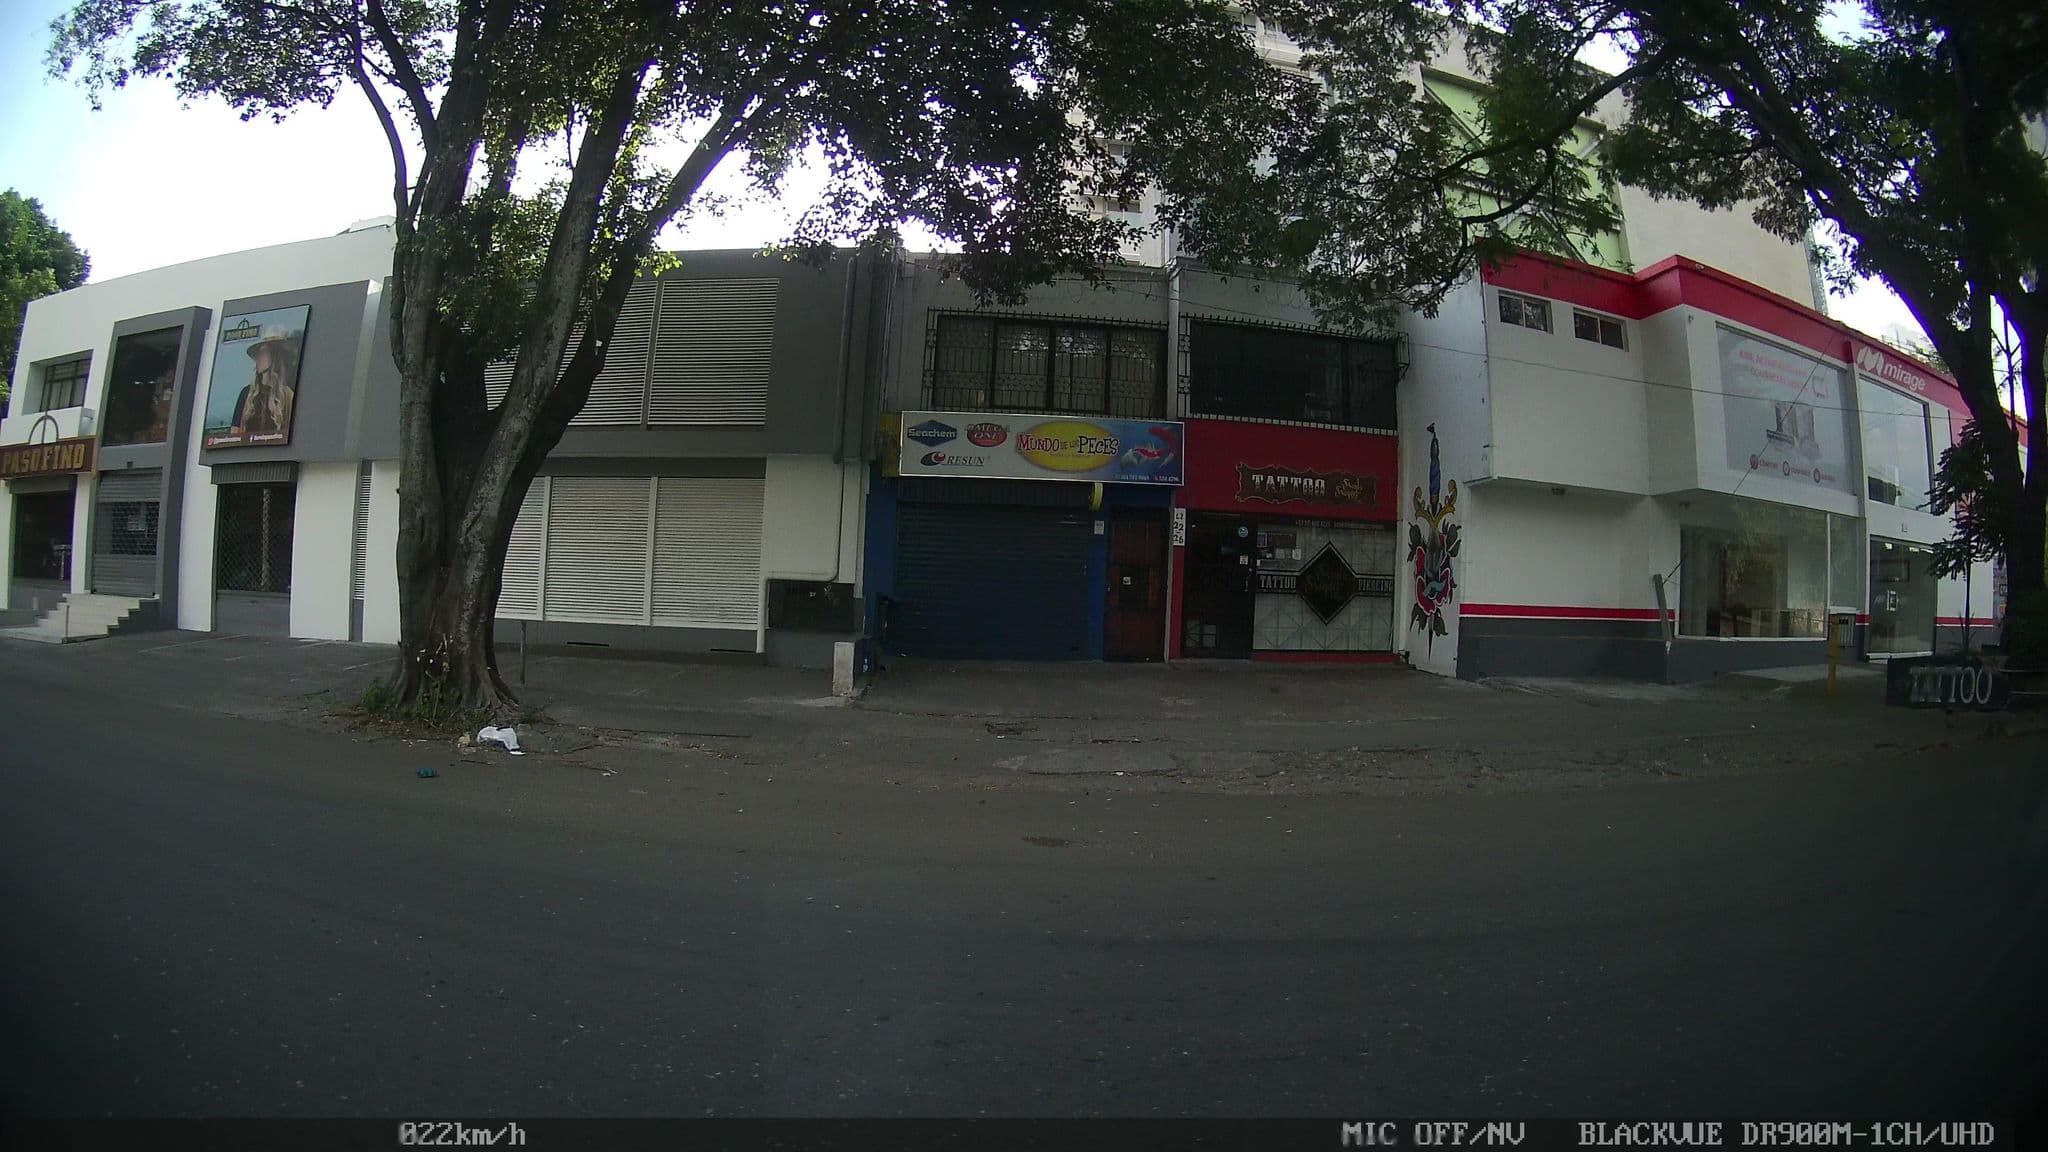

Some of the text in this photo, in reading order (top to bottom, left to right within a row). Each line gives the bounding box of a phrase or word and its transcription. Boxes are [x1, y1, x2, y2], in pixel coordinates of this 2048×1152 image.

[1884, 363, 1926, 391] mirage
[907, 427, 956, 438] Seachem
[1078, 435, 1119, 455] PECES
[947, 455, 985, 465] RESUN
[1251, 474, 1326, 497] TATTOO
[1259, 575, 1297, 589] TATTOO
